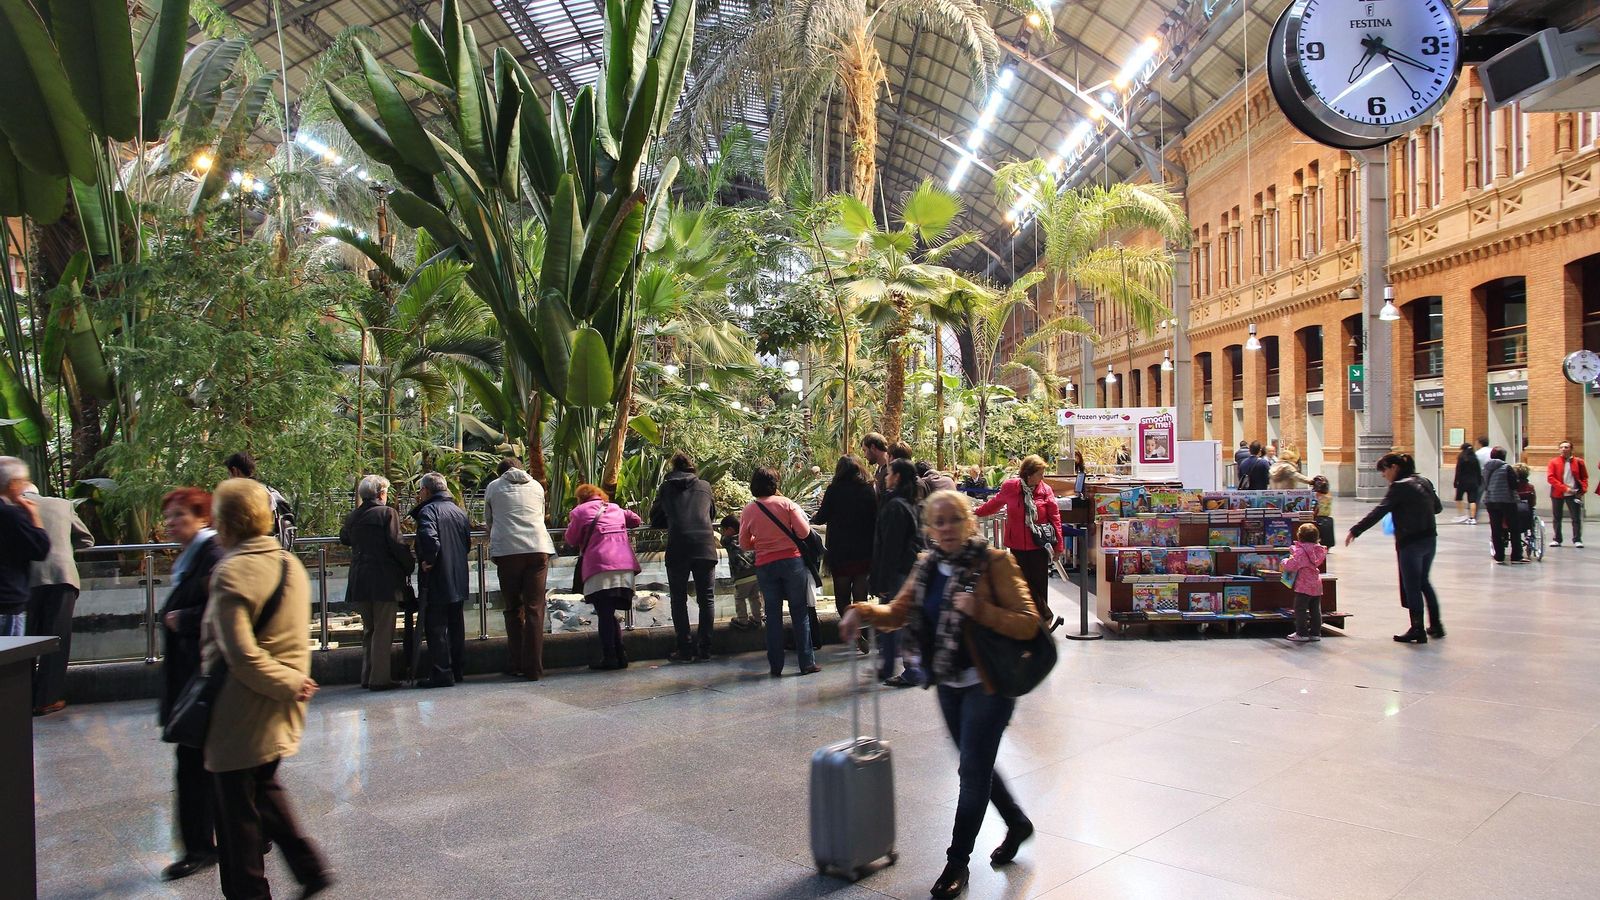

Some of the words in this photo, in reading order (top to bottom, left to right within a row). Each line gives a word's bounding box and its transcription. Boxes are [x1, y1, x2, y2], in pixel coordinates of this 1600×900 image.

[1350, 18, 1392, 29] FESTINA
[1306, 41, 1325, 61] 9
[1421, 36, 1440, 55] 3
[1367, 96, 1386, 116] 6
[1098, 413, 1119, 421] yogurt
[1141, 413, 1172, 424] smooth
